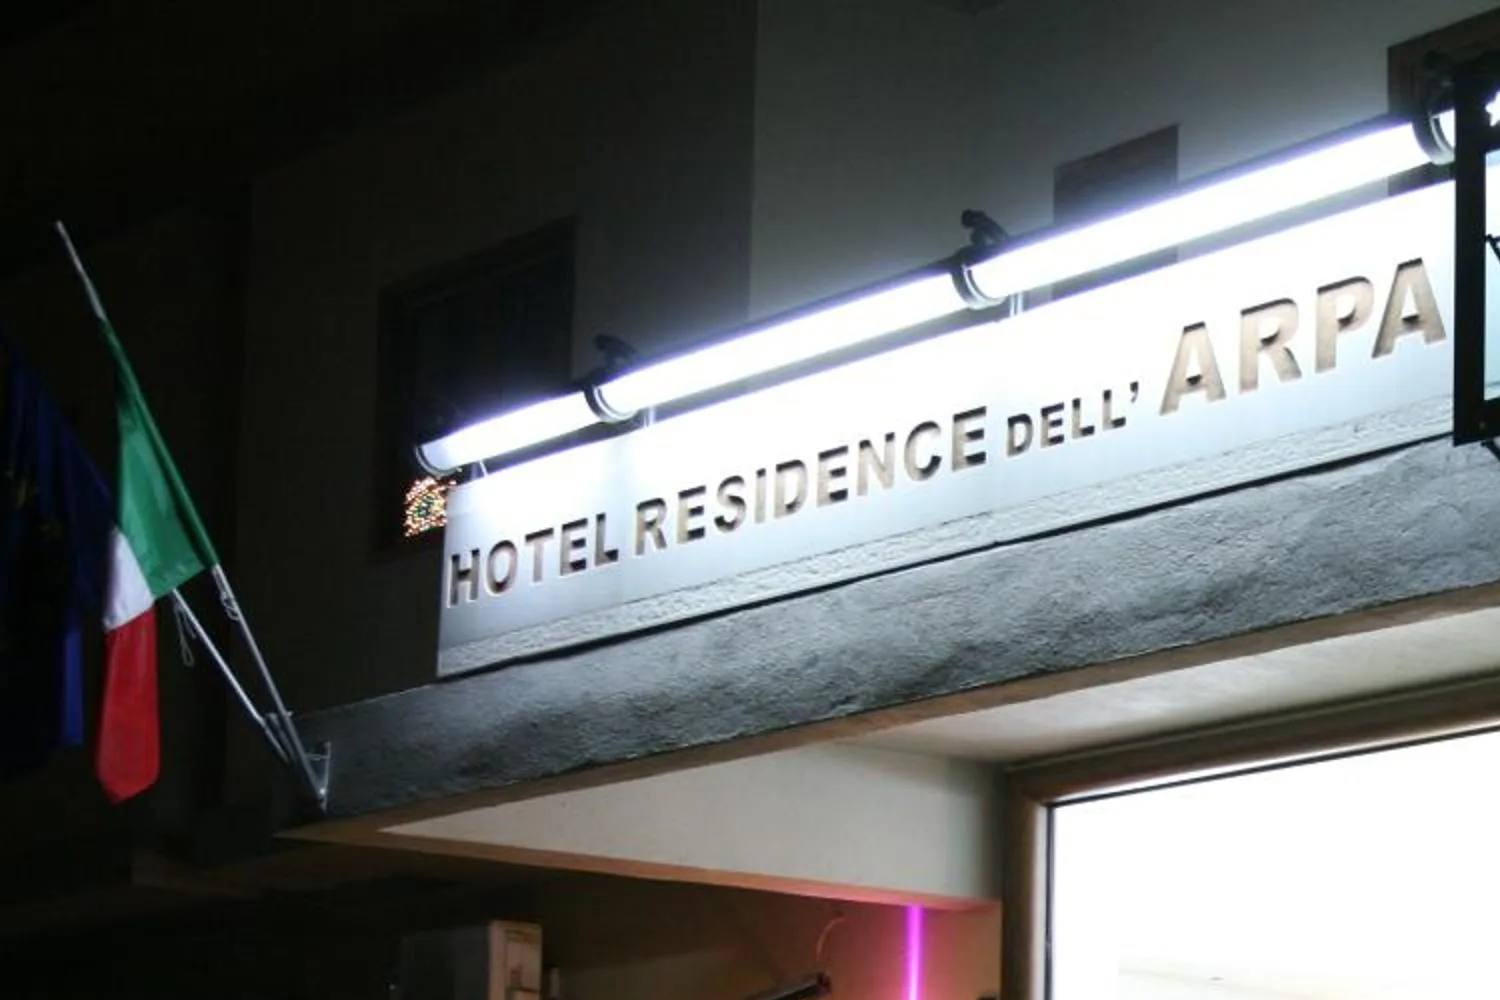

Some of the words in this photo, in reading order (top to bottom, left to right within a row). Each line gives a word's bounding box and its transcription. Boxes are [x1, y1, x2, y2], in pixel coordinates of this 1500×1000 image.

[448, 511, 620, 608] HOTEL
[634, 405, 987, 556] RESIDENCE
[1005, 381, 1139, 457] DELL'
[1158, 256, 1448, 417] ARPA
